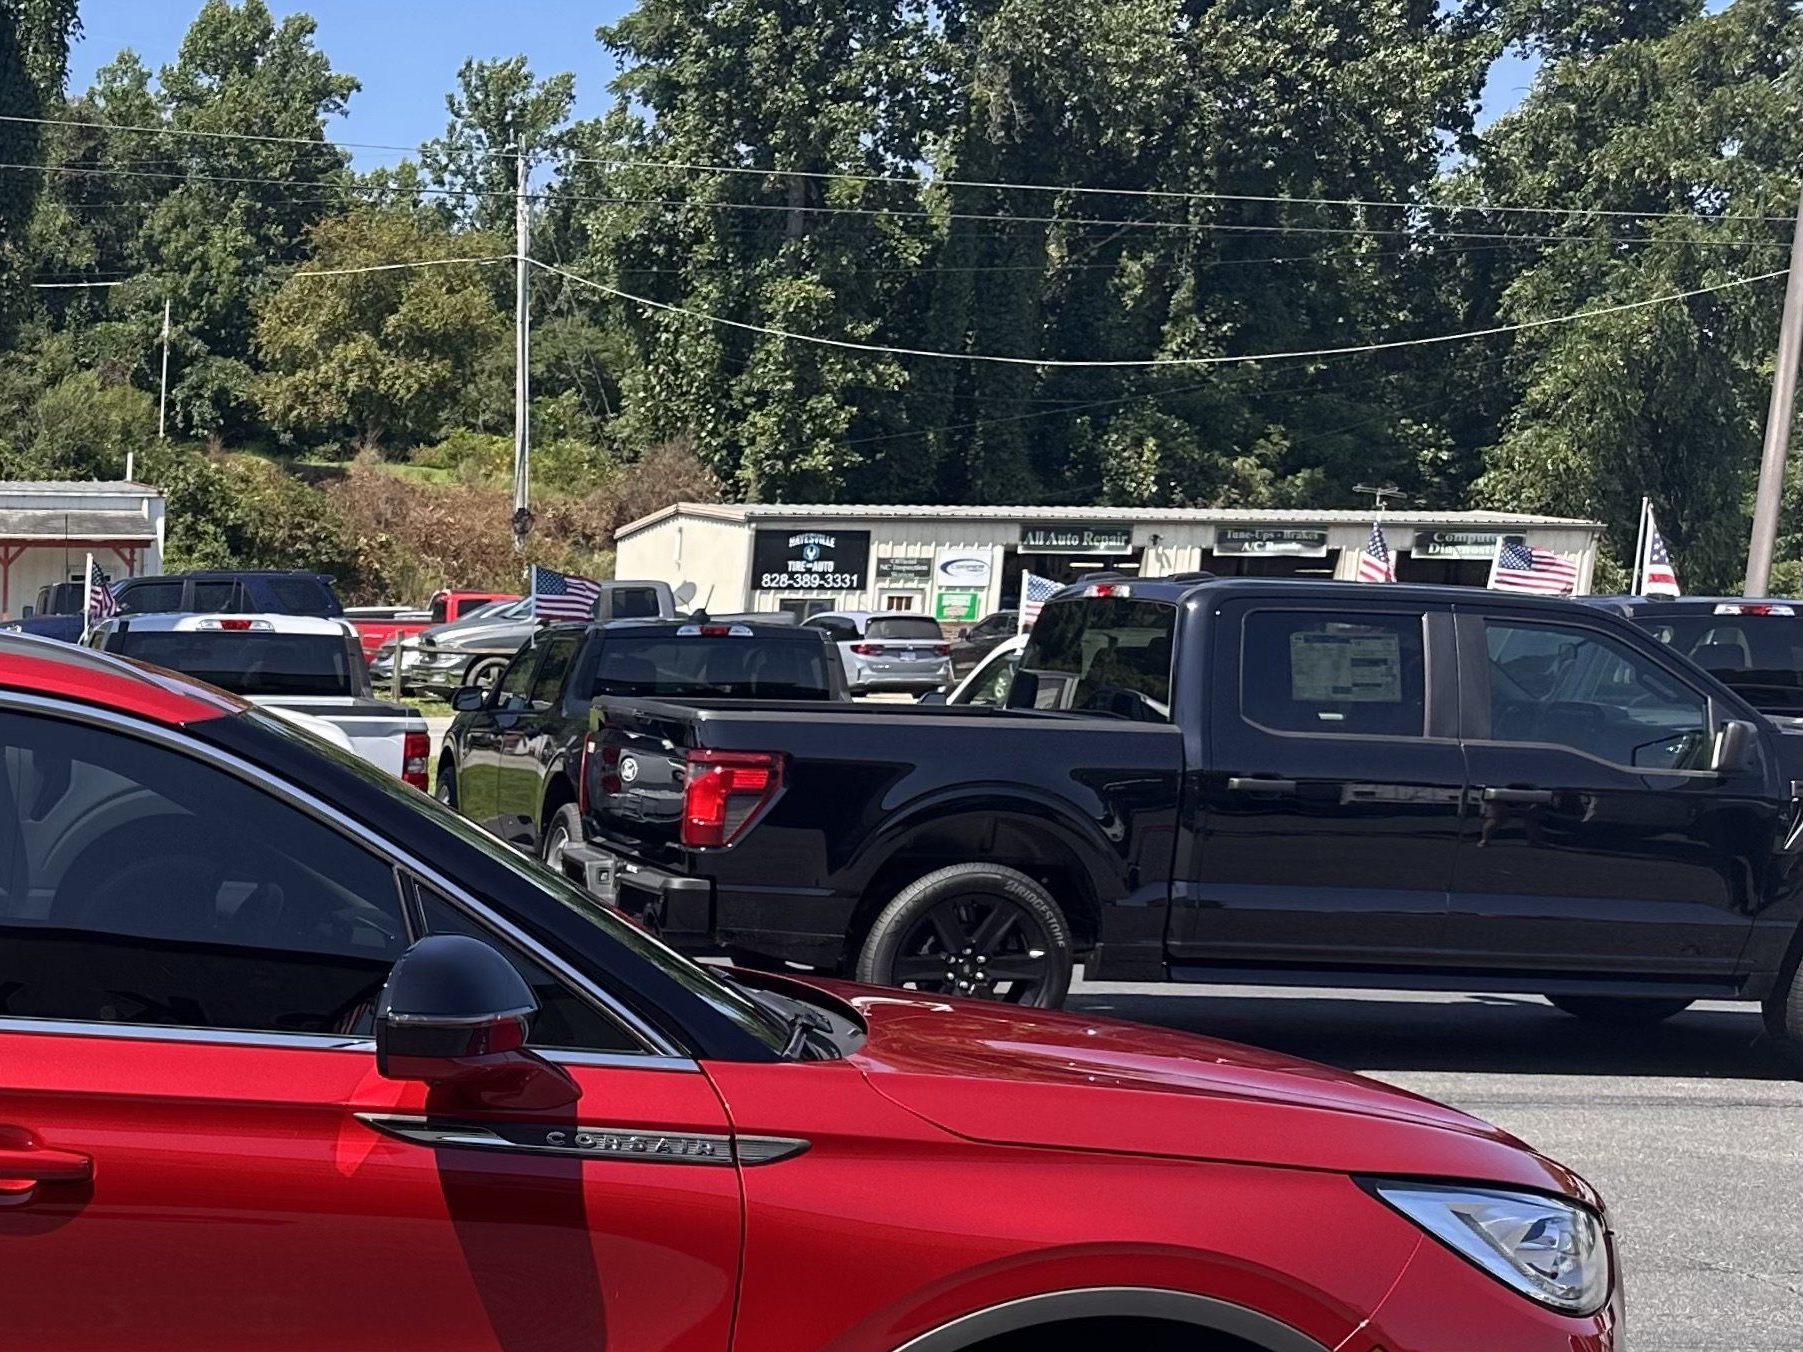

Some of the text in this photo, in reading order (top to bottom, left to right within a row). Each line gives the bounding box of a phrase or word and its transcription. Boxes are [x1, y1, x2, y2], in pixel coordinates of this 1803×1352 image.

[1023, 531, 1129, 550] All Auto Repair
[1433, 532, 1498, 545] Compute
[1428, 543, 1496, 555] Diagnosti
[812, 561, 834, 573] AUTO
[761, 573, 858, 588] 828-389-3331
[1002, 879, 1067, 950] BRIDGESTONE
[545, 1130, 717, 1157] CORSAIR
